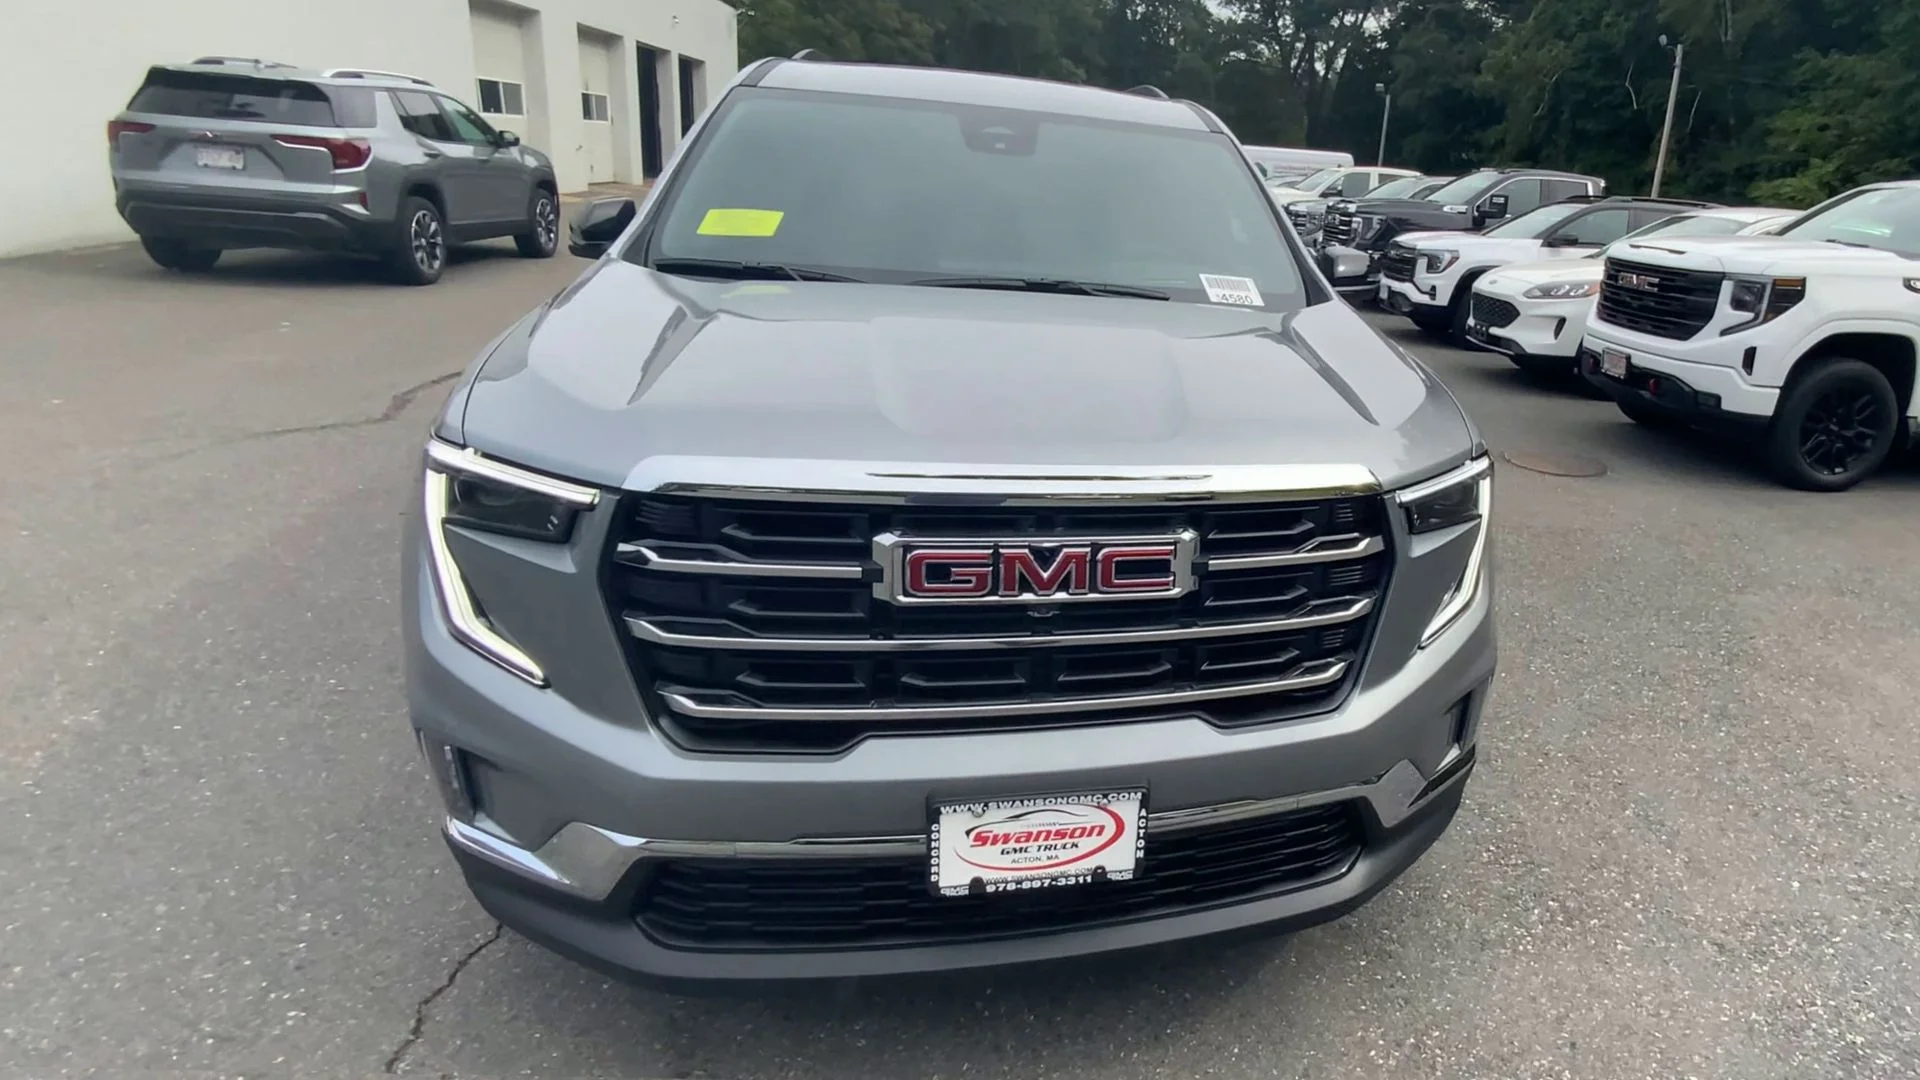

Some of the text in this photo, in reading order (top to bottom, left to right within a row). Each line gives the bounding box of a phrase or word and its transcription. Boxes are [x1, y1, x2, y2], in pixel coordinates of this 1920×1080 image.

[1617, 271, 1660, 292] GMC
[906, 545, 1176, 597] GMC
[940, 791, 1143, 815] WWW.SWANSONGMC.COM
[970, 824, 1106, 848] Swanson
[1135, 808, 1147, 859] ACTON
[930, 823, 940, 882] CONCORD
[1000, 841, 1080, 856] GMC TRUCK
[985, 874, 1092, 893] 978-897-3311
